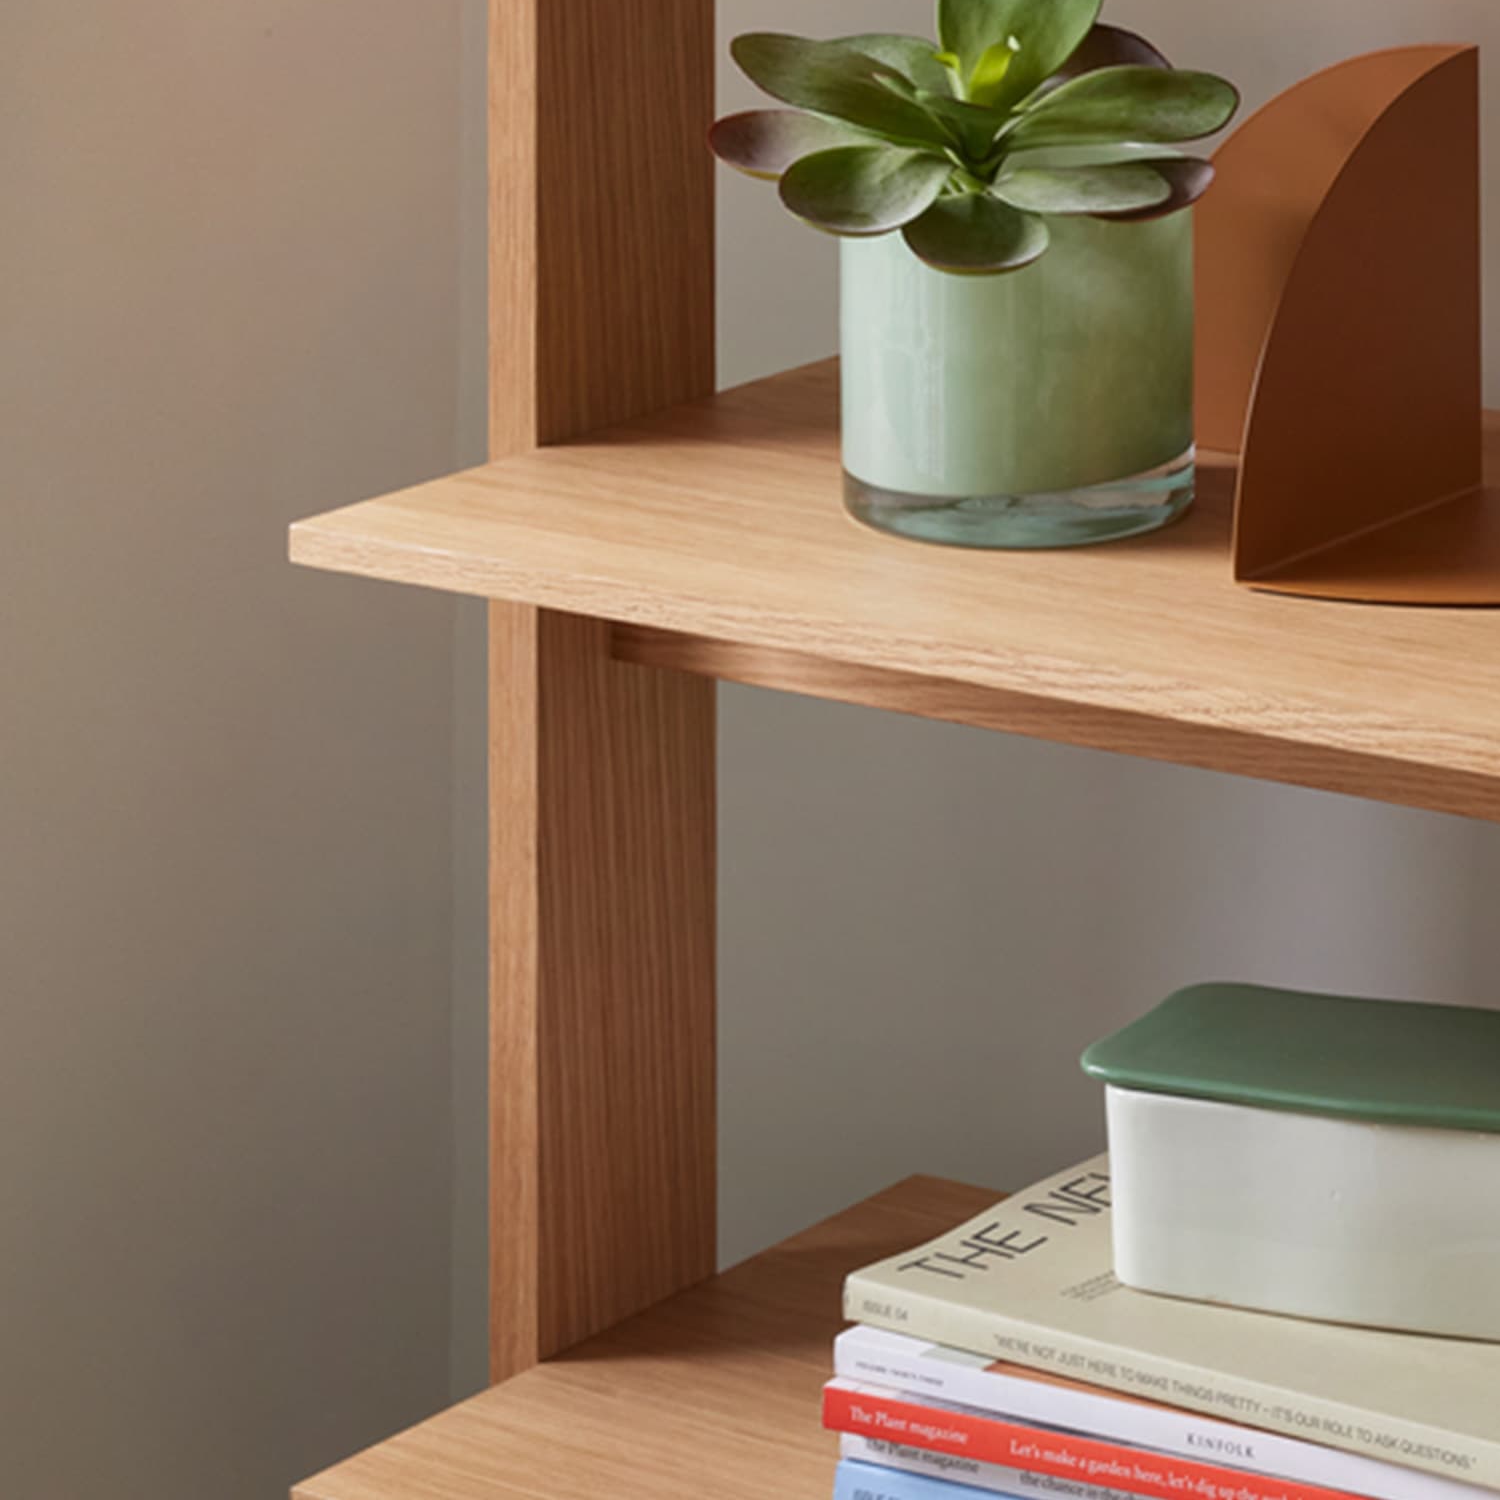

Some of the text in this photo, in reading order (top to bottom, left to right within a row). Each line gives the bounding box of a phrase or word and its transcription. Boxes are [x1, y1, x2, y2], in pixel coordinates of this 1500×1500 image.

[897, 1171, 1112, 1280] THE NE
[1032, 1344, 1056, 1360] NOT
[1058, 1351, 1085, 1368] JUST
[1088, 1359, 1117, 1378] HERE
[1172, 1379, 1213, 1401] THINGS
[1216, 1389, 1261, 1413] PRETTY
[1295, 1411, 1320, 1430] OUR
[1323, 1417, 1353, 1439] ROLE
[1356, 1426, 1372, 1444] TO
[1375, 1433, 1399, 1450] ASK
[850, 1405, 968, 1445] The Plant magazine
[922, 1452, 979, 1473] magazine
[1010, 1438, 1041, 1459] Let's
[1043, 1448, 1076, 1468] make
[1078, 1458, 1086, 1469] a
[1088, 1459, 1131, 1477] garden
[1187, 1432, 1255, 1458] KINFOLK
